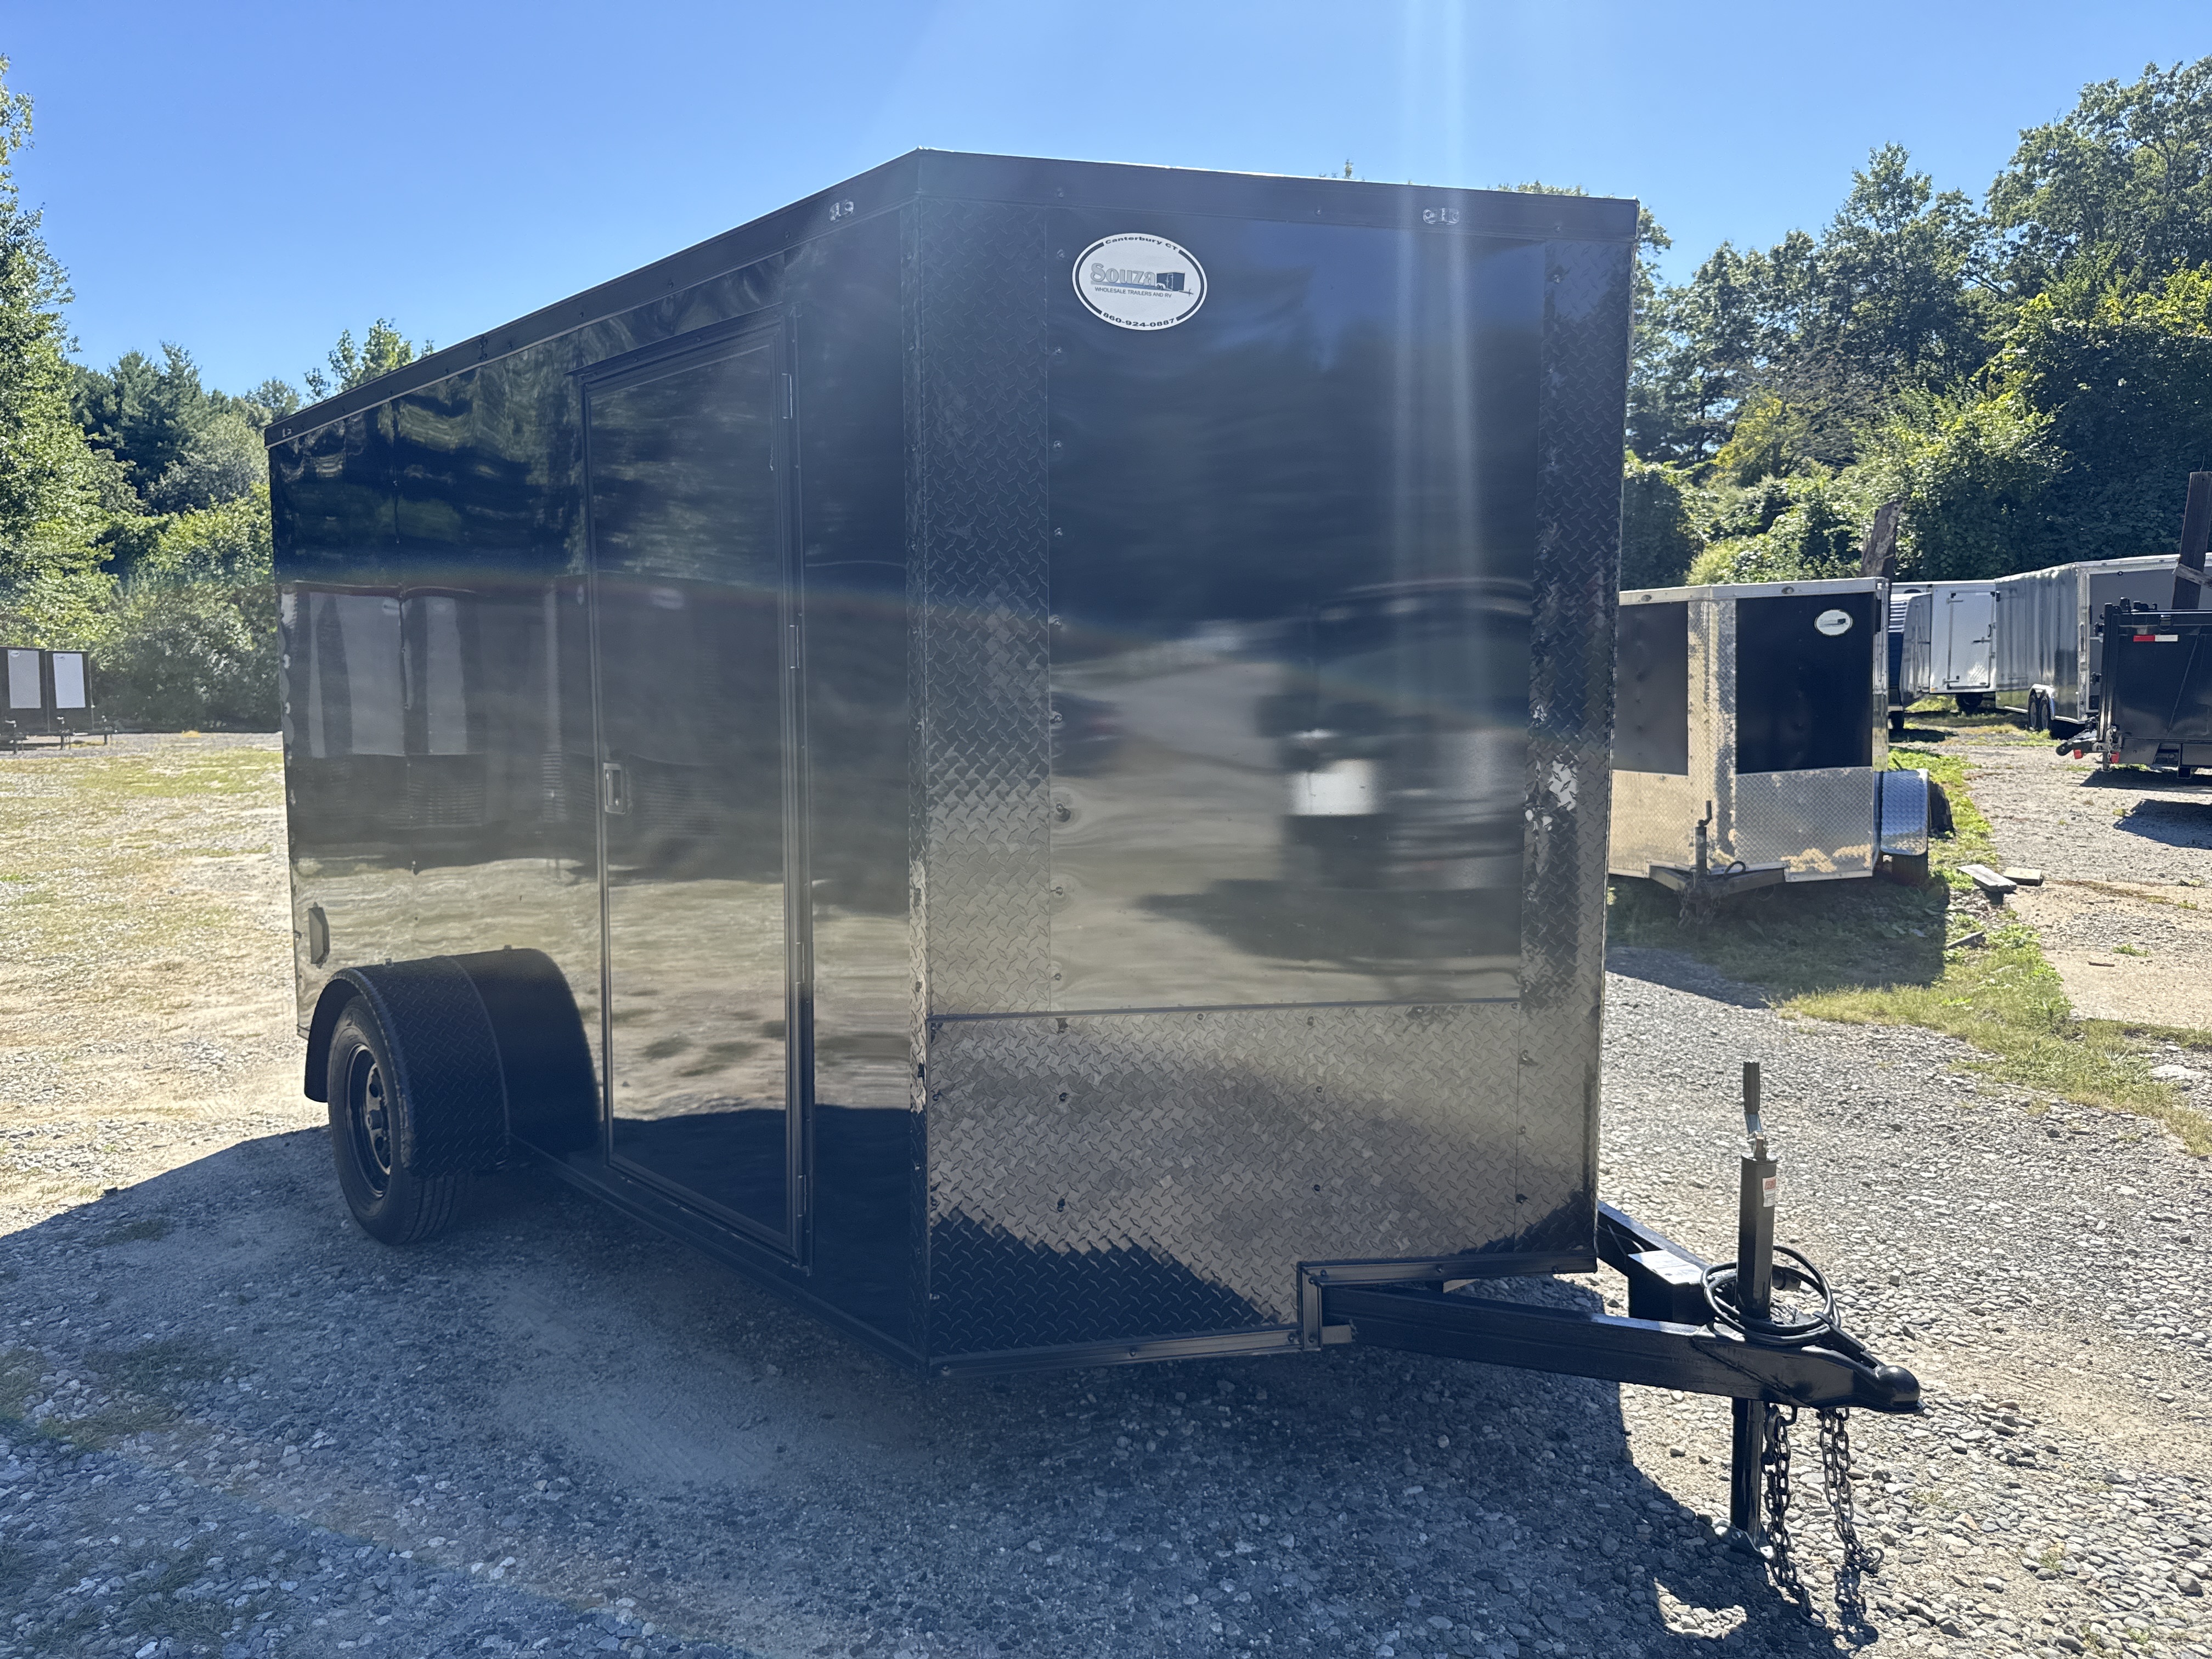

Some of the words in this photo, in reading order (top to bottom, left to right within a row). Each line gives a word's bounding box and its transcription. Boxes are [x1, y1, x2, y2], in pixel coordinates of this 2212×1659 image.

[1105, 236, 1162, 245] Canterbury
[1090, 263, 1156, 286] Souza
[1103, 312, 1175, 327] 860-924-0887
